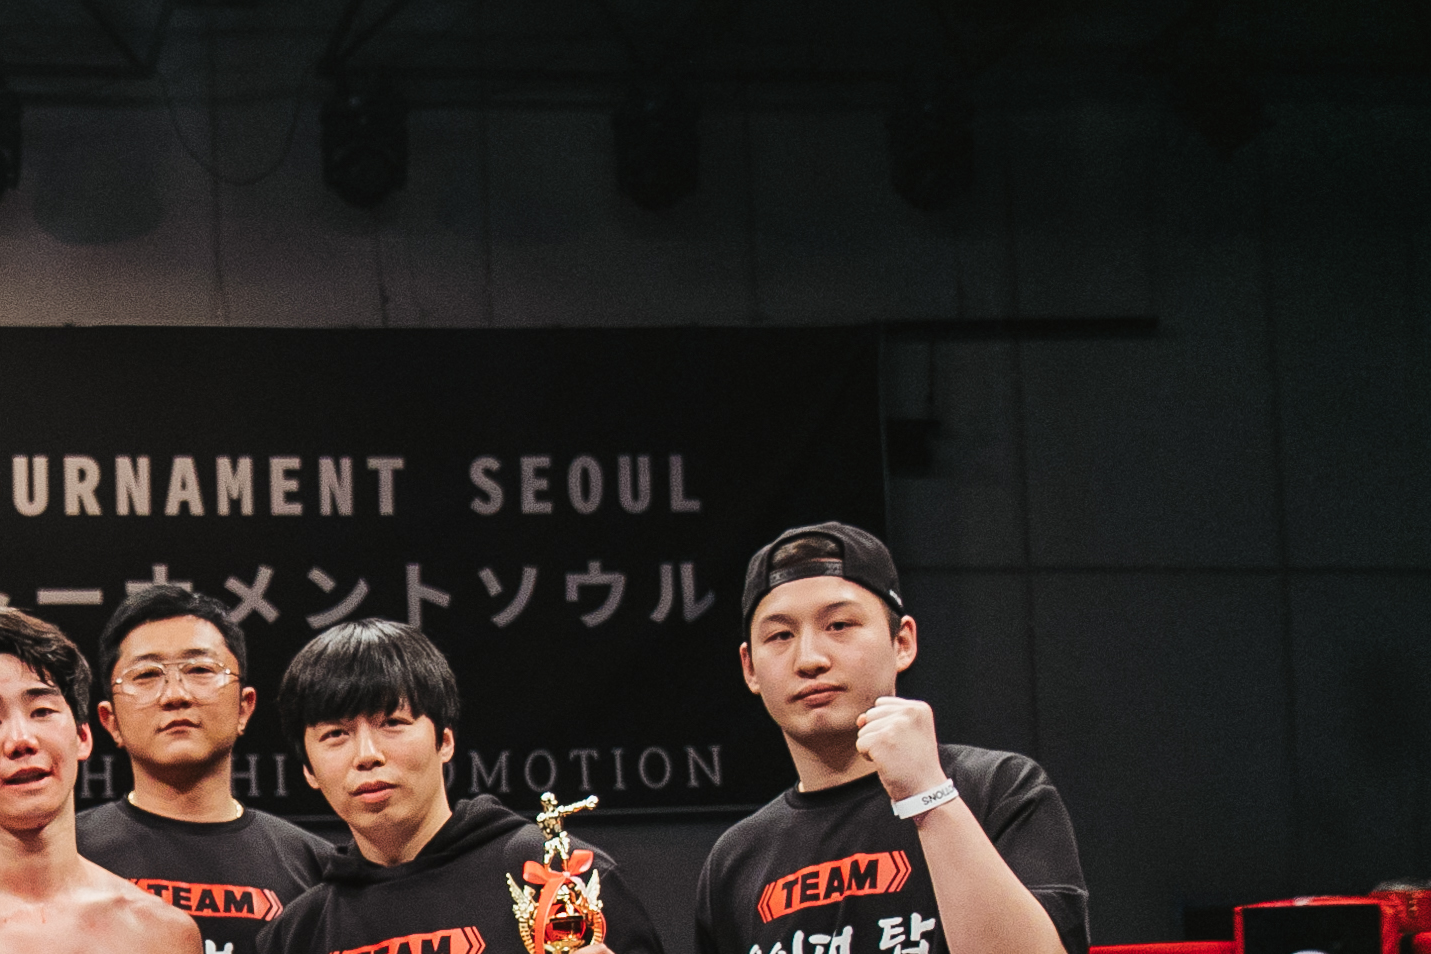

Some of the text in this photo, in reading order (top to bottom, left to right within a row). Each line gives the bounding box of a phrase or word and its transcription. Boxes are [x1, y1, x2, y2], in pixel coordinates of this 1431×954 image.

[469, 455, 701, 515] SEOUL
[146, 884, 255, 915] TEAM
[781, 859, 879, 910] TEAM
